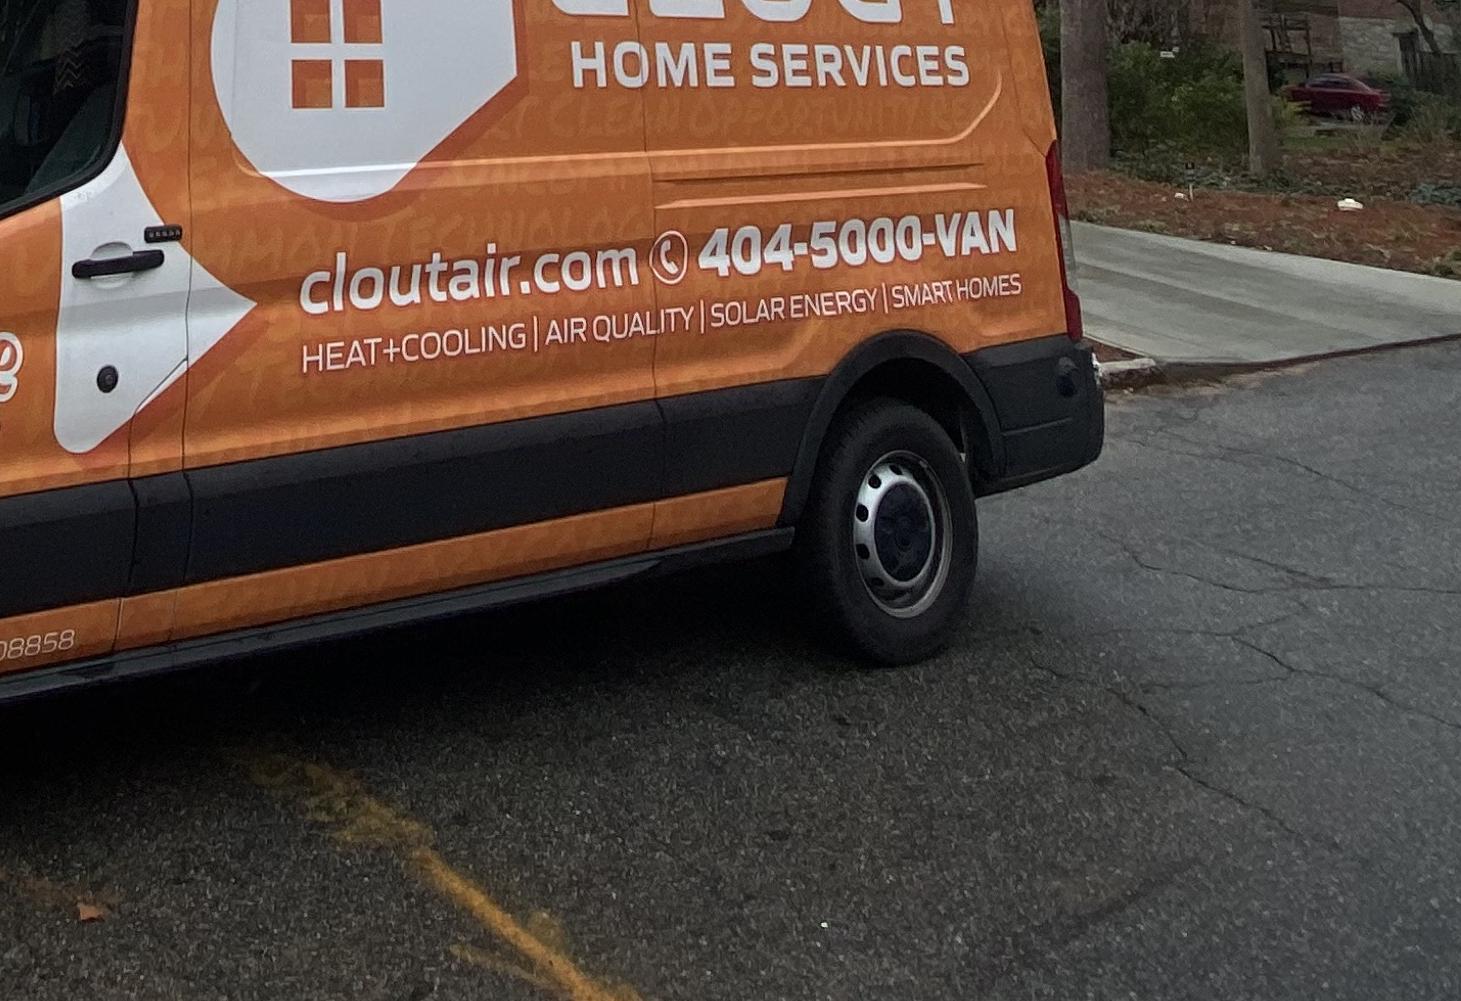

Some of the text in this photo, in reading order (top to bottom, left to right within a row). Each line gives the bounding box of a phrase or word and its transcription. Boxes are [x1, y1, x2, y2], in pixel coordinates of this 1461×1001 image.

[571, 40, 970, 88] HOME SERVICES
[300, 209, 1018, 314] cloutair.com 404-5000-VAN
[303, 274, 1022, 373] HEAT+COOLING AIR QUALITY SOLAR ENERGY SMART HOMES
